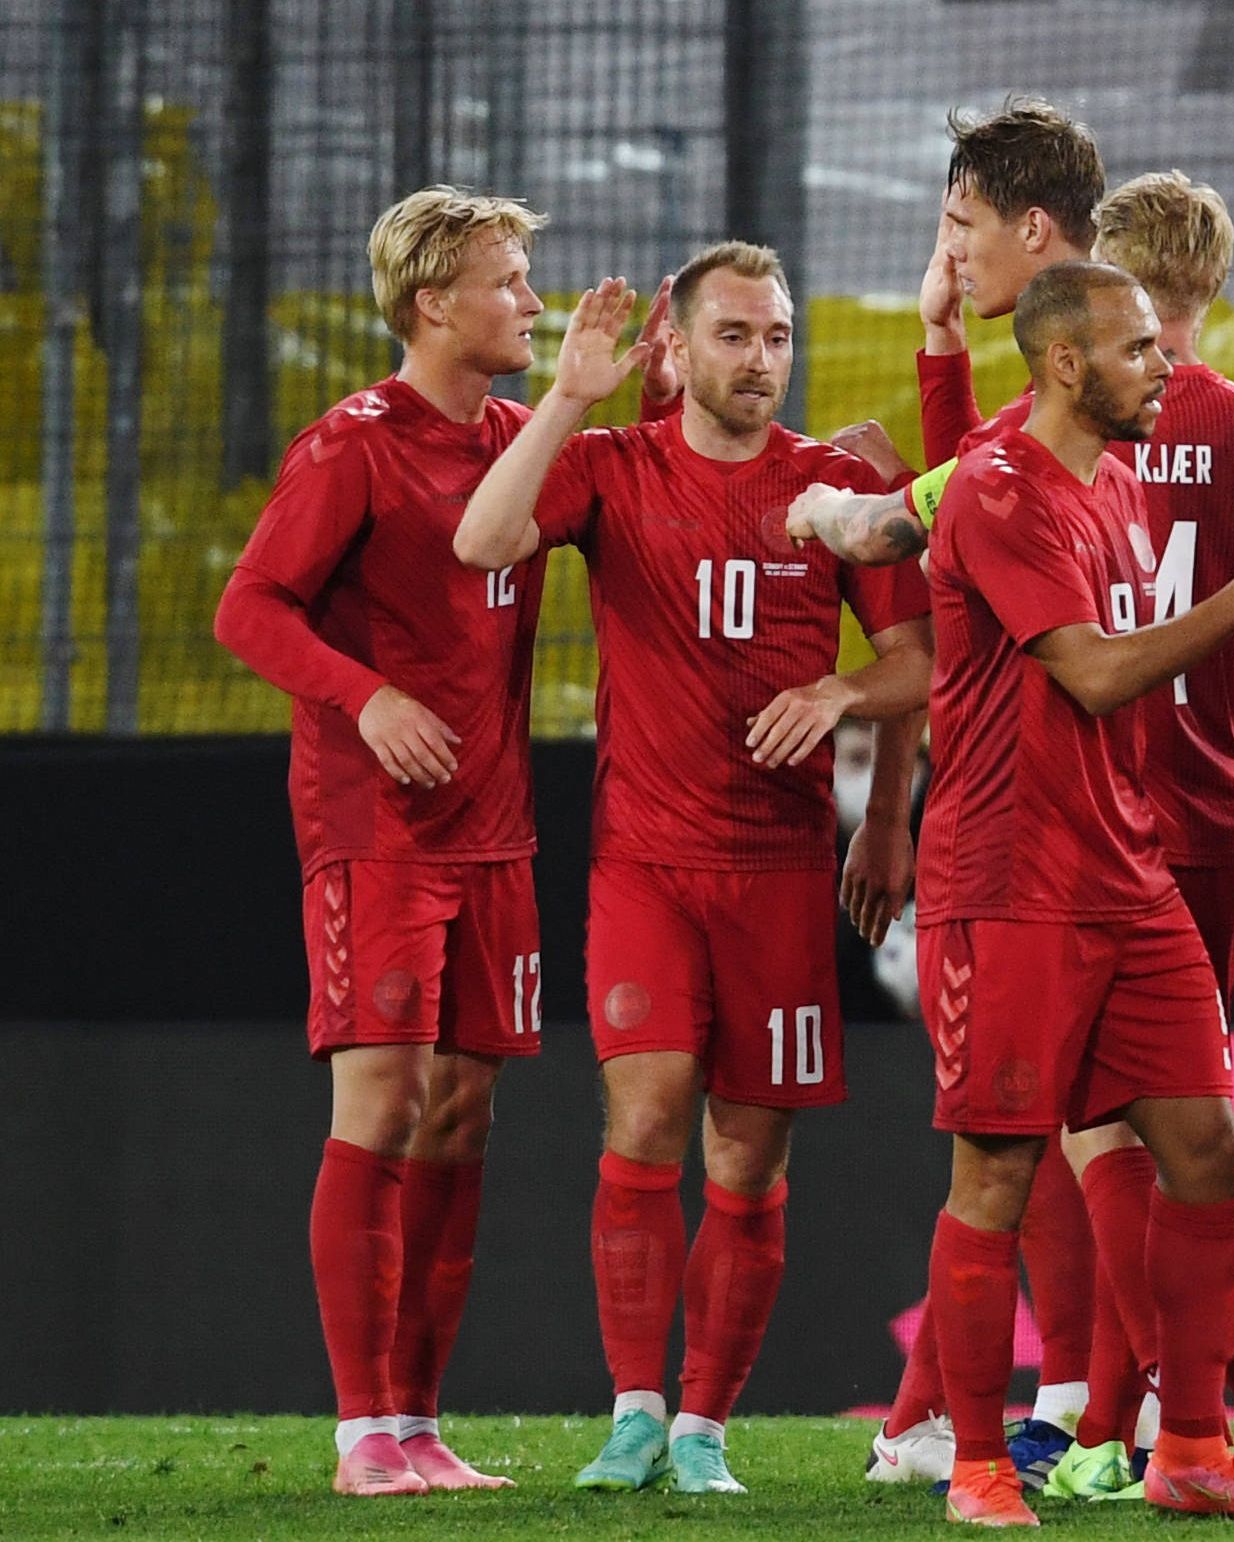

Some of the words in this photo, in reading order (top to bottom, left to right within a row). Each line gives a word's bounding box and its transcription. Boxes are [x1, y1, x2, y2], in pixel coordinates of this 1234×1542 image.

[1134, 443, 1212, 484] KJÆR
[695, 559, 756, 639] 10
[1109, 582, 1136, 632] 9
[1153, 520, 1197, 705] 4
[512, 952, 541, 1034] 12
[767, 1005, 824, 1085] 10
